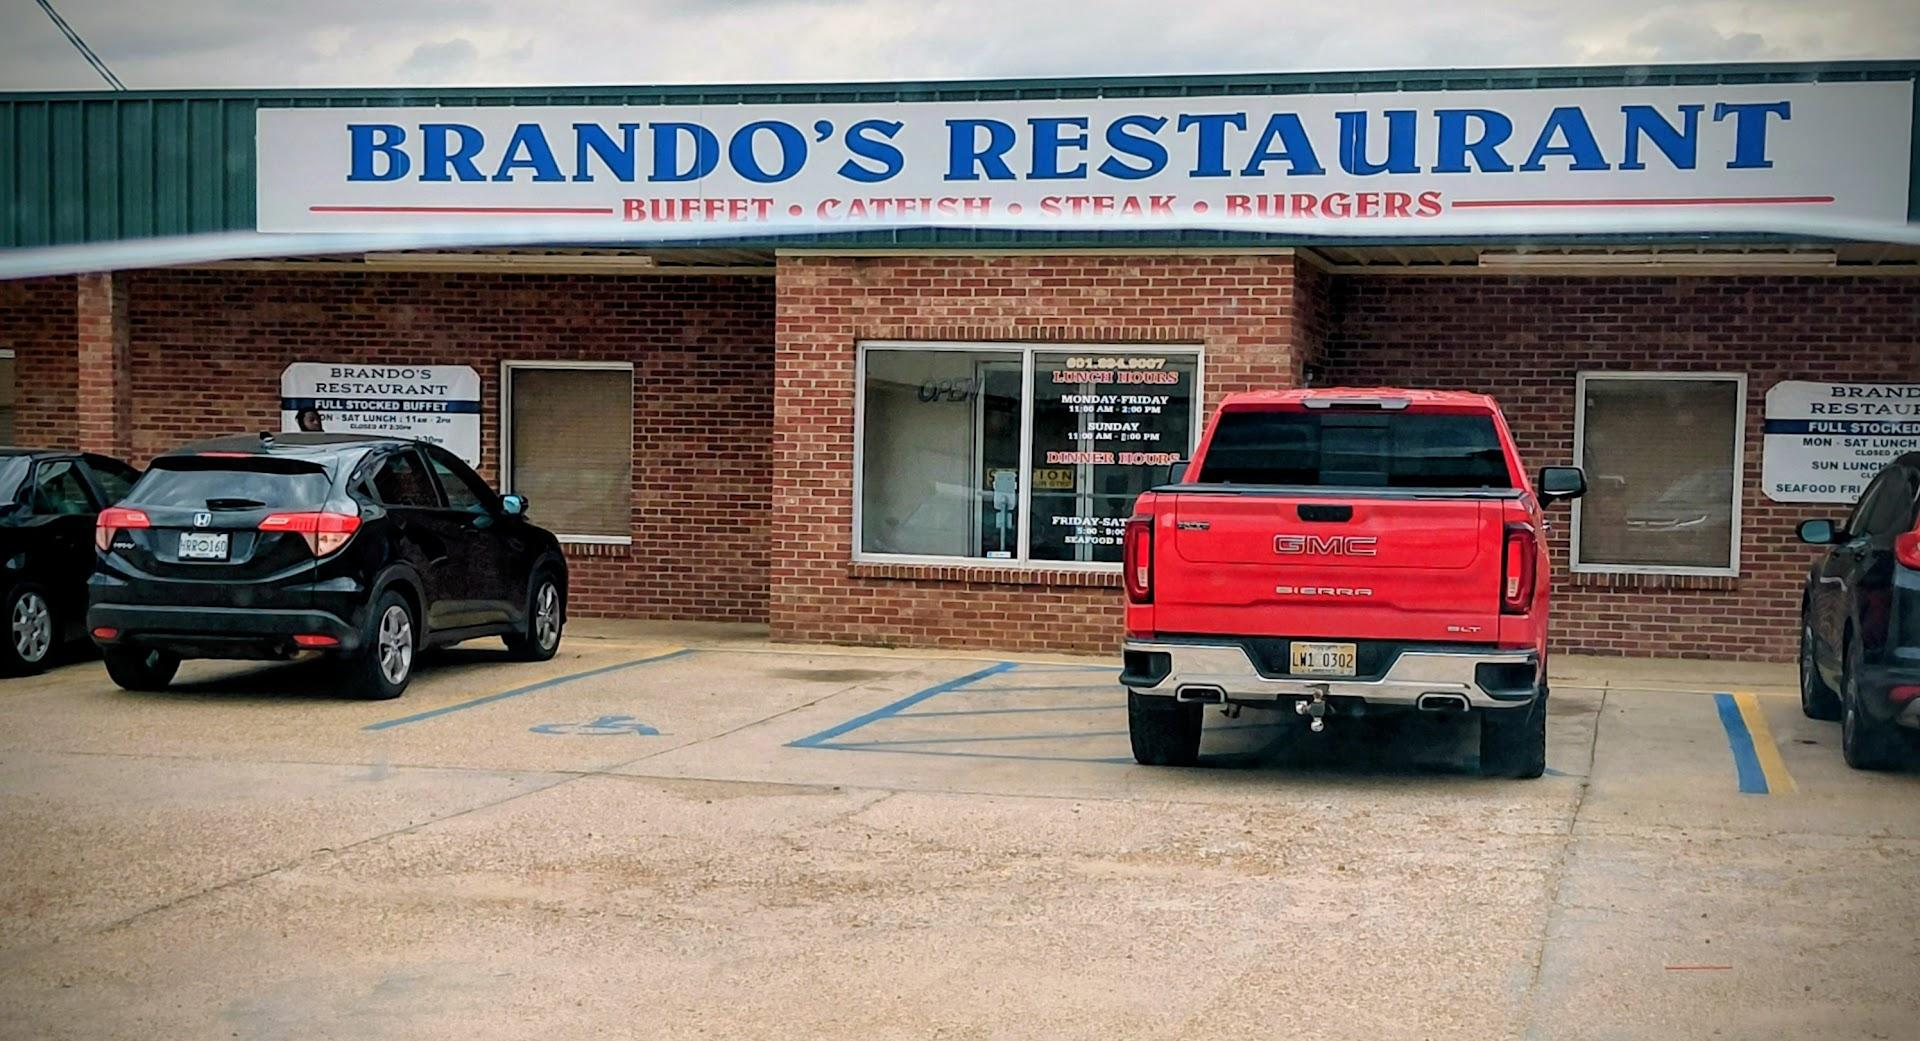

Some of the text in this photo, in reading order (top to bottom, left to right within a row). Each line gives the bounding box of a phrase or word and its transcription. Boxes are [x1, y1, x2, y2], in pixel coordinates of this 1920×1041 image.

[346, 101, 1792, 183] BRANDO'S RESTAURANT
[622, 191, 1443, 223] BUFFET CATFISH STEAK BURGERS
[331, 368, 432, 380] BRANDO'S
[1053, 370, 1179, 384] LUNCH HOURS
[316, 383, 448, 395] RESTAURANT
[1831, 386, 1920, 399] BRAND
[315, 400, 448, 412] FULL STOCKED BUFFET
[1061, 395, 1169, 405] MONDAY-FRIDAY
[1096, 405, 1113, 413] AM
[1144, 406, 1161, 414] PM
[1810, 402, 1920, 415] RESTAU
[342, 414, 360, 423] SAT
[363, 414, 396, 423] LUNCH
[1088, 422, 1140, 431] SUNDAY
[1808, 422, 1920, 434] FULL STOCKED
[1095, 432, 1112, 440] AM
[1121, 432, 1141, 441] :00
[1143, 433, 1160, 441] PM
[1803, 437, 1832, 447] MON
[1844, 438, 1869, 447] SAT
[1873, 439, 1917, 448] LUNCH
[1047, 451, 1180, 466] DINNER HOURS
[1812, 461, 1886, 471] SUN LUNCH
[1776, 483, 1861, 494] SEAFOOD FRI
[1052, 516, 1128, 527] FRIDAY-SAT
[1064, 536, 1114, 545] SEAFOOD
[1273, 534, 1377, 556] GMC
[1276, 586, 1373, 596] SIERRA
[1323, 653, 1354, 668] 0302
